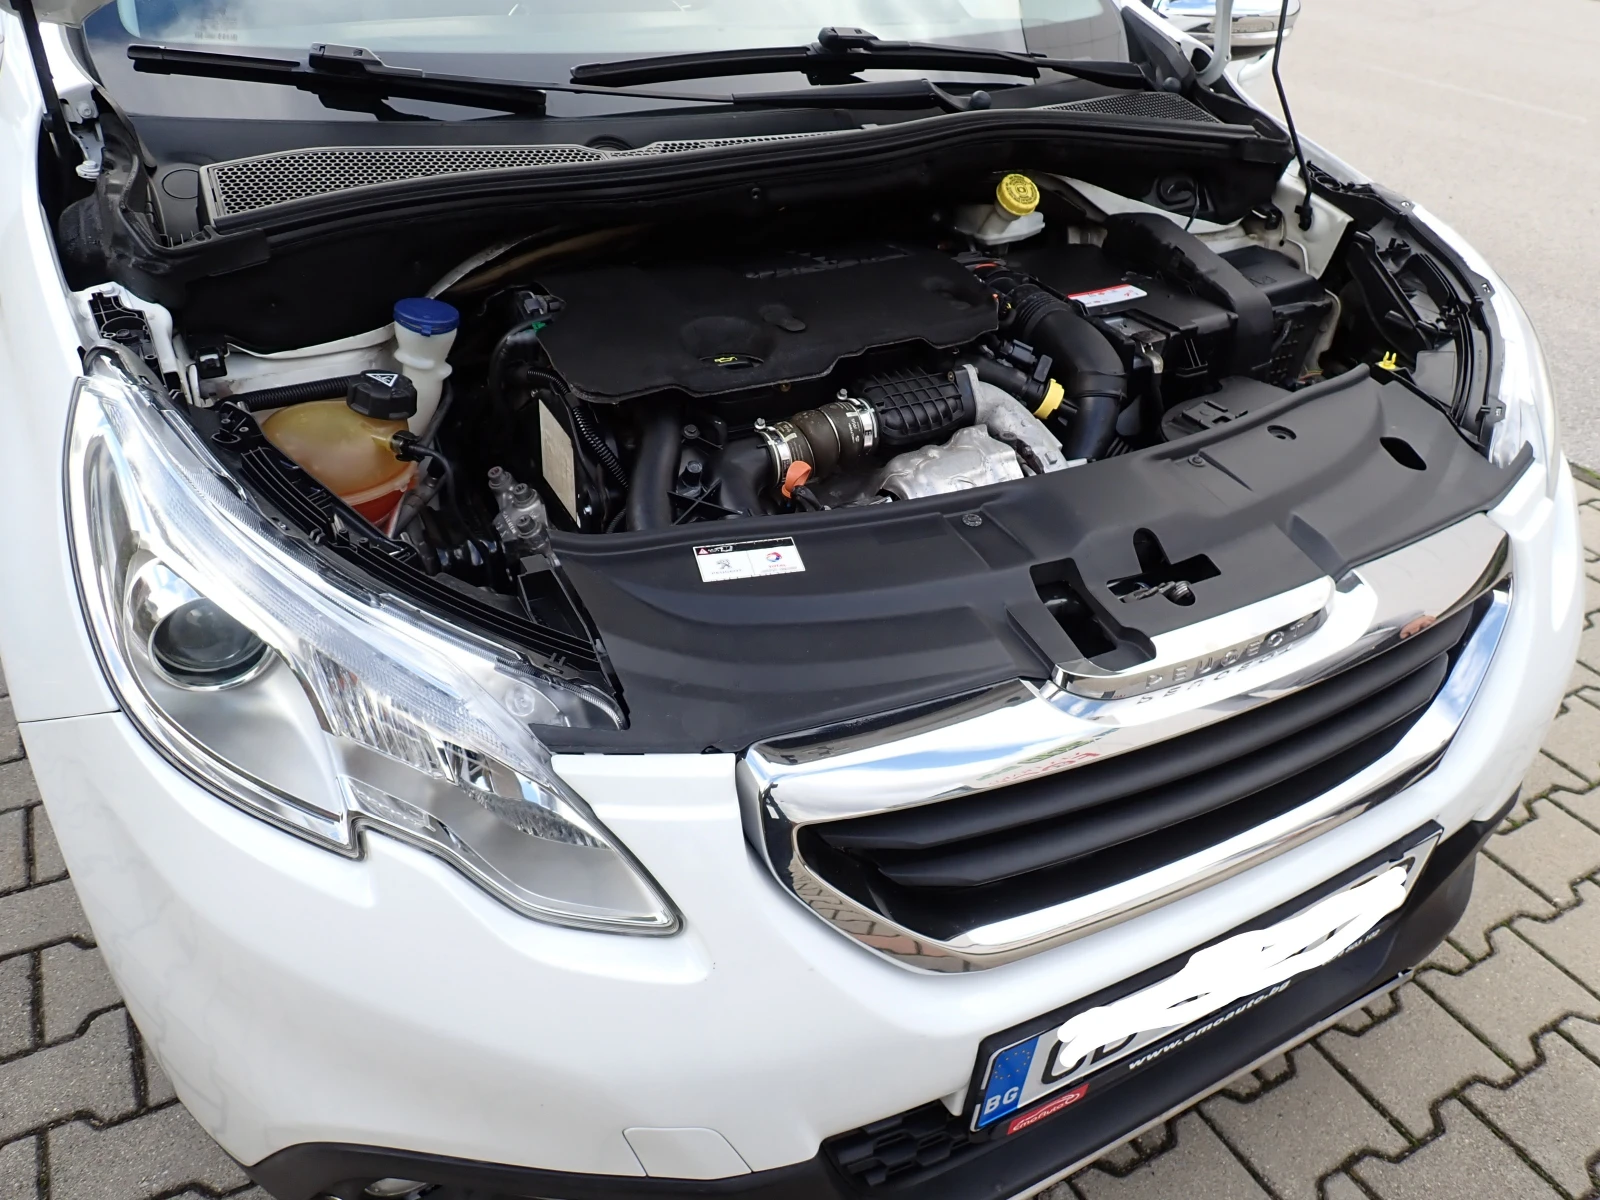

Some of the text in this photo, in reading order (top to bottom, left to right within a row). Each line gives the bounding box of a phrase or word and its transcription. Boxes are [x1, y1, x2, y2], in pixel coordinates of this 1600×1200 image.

[1145, 621, 1304, 690] PEUGEOT
[1129, 979, 1291, 1070] www.emoauto.bg
[983, 1086, 1020, 1116] BG
